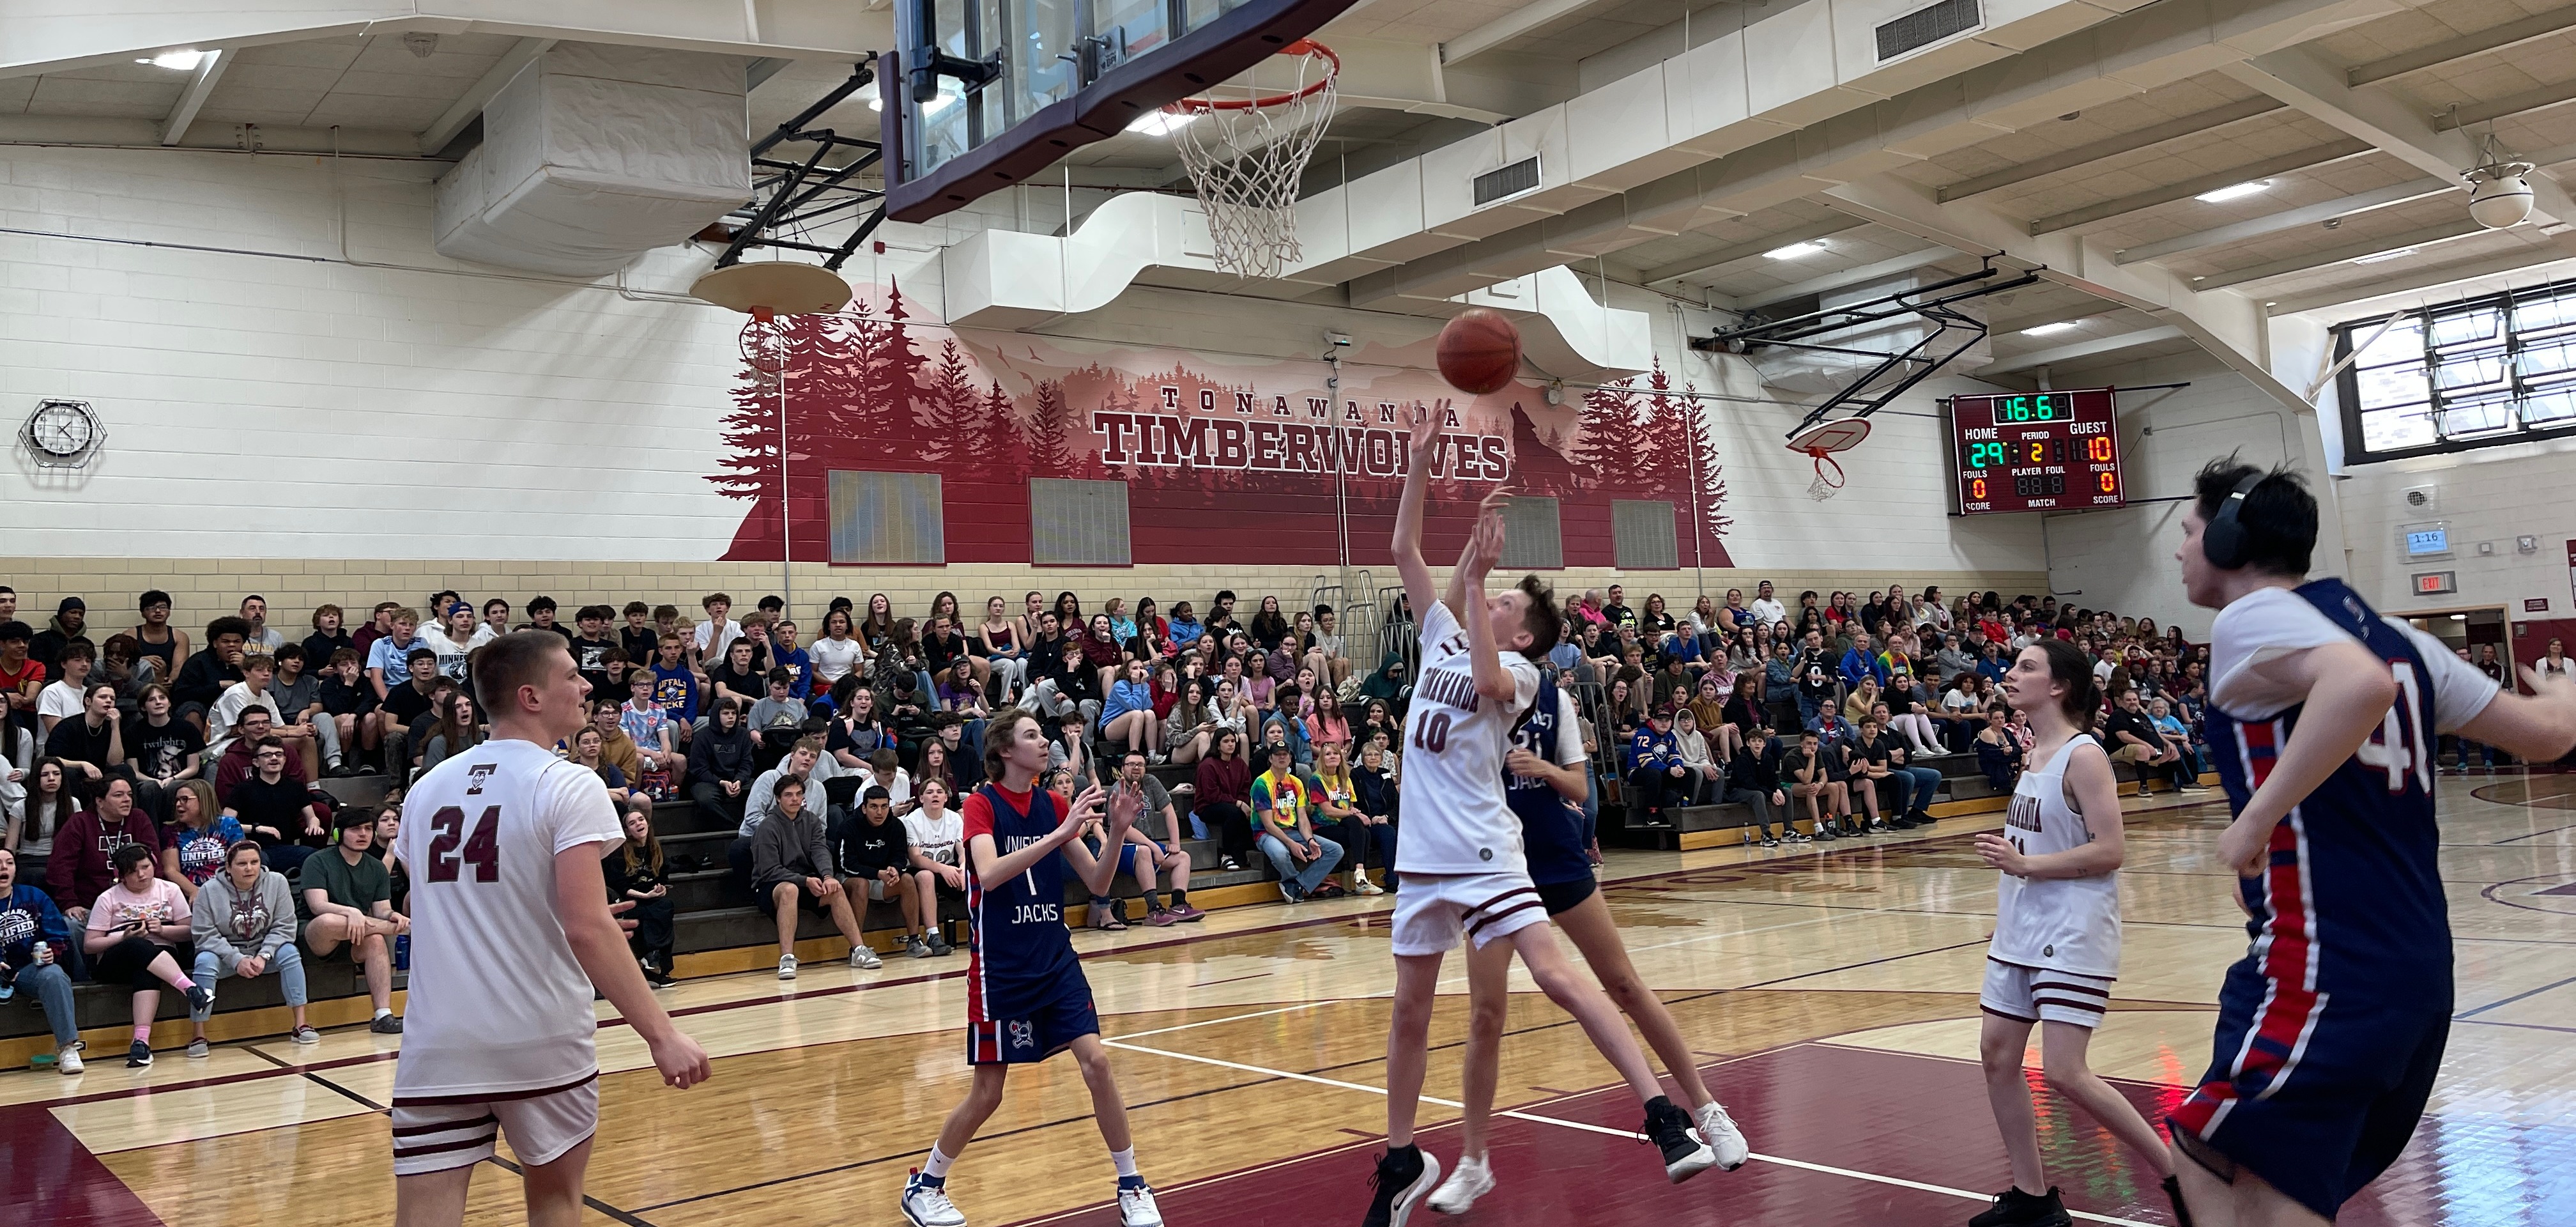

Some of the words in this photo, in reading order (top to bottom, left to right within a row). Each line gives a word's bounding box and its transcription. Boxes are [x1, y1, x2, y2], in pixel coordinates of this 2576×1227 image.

[2006, 396, 2053, 421] 16.6
[1965, 428, 1998, 440] HOME
[2069, 422, 2107, 435] GUEST
[2021, 431, 2050, 440] PERIOD
[1971, 442, 2003, 468] 29
[2031, 443, 2043, 461] 2
[2088, 437, 2112, 461] 10
[2012, 468, 2041, 476] PLAYER
[2046, 466, 2066, 474] FOUL
[2090, 463, 2115, 472] FOULS
[1963, 470, 1988, 479] FOULS
[1973, 479, 1986, 498] 0
[2101, 473, 2114, 492] 0
[2028, 498, 2055, 507] MATCH
[2093, 495, 2119, 504] SCORE
[1966, 502, 1991, 511] SCORE
[2415, 532, 2438, 543] 1:16
[1414, 709, 1451, 753] 10
[1637, 736, 1650, 748] 72
[428, 805, 502, 883] 24
[181, 849, 224, 861] UNIFIED
[1012, 904, 1058, 924] JACKS
